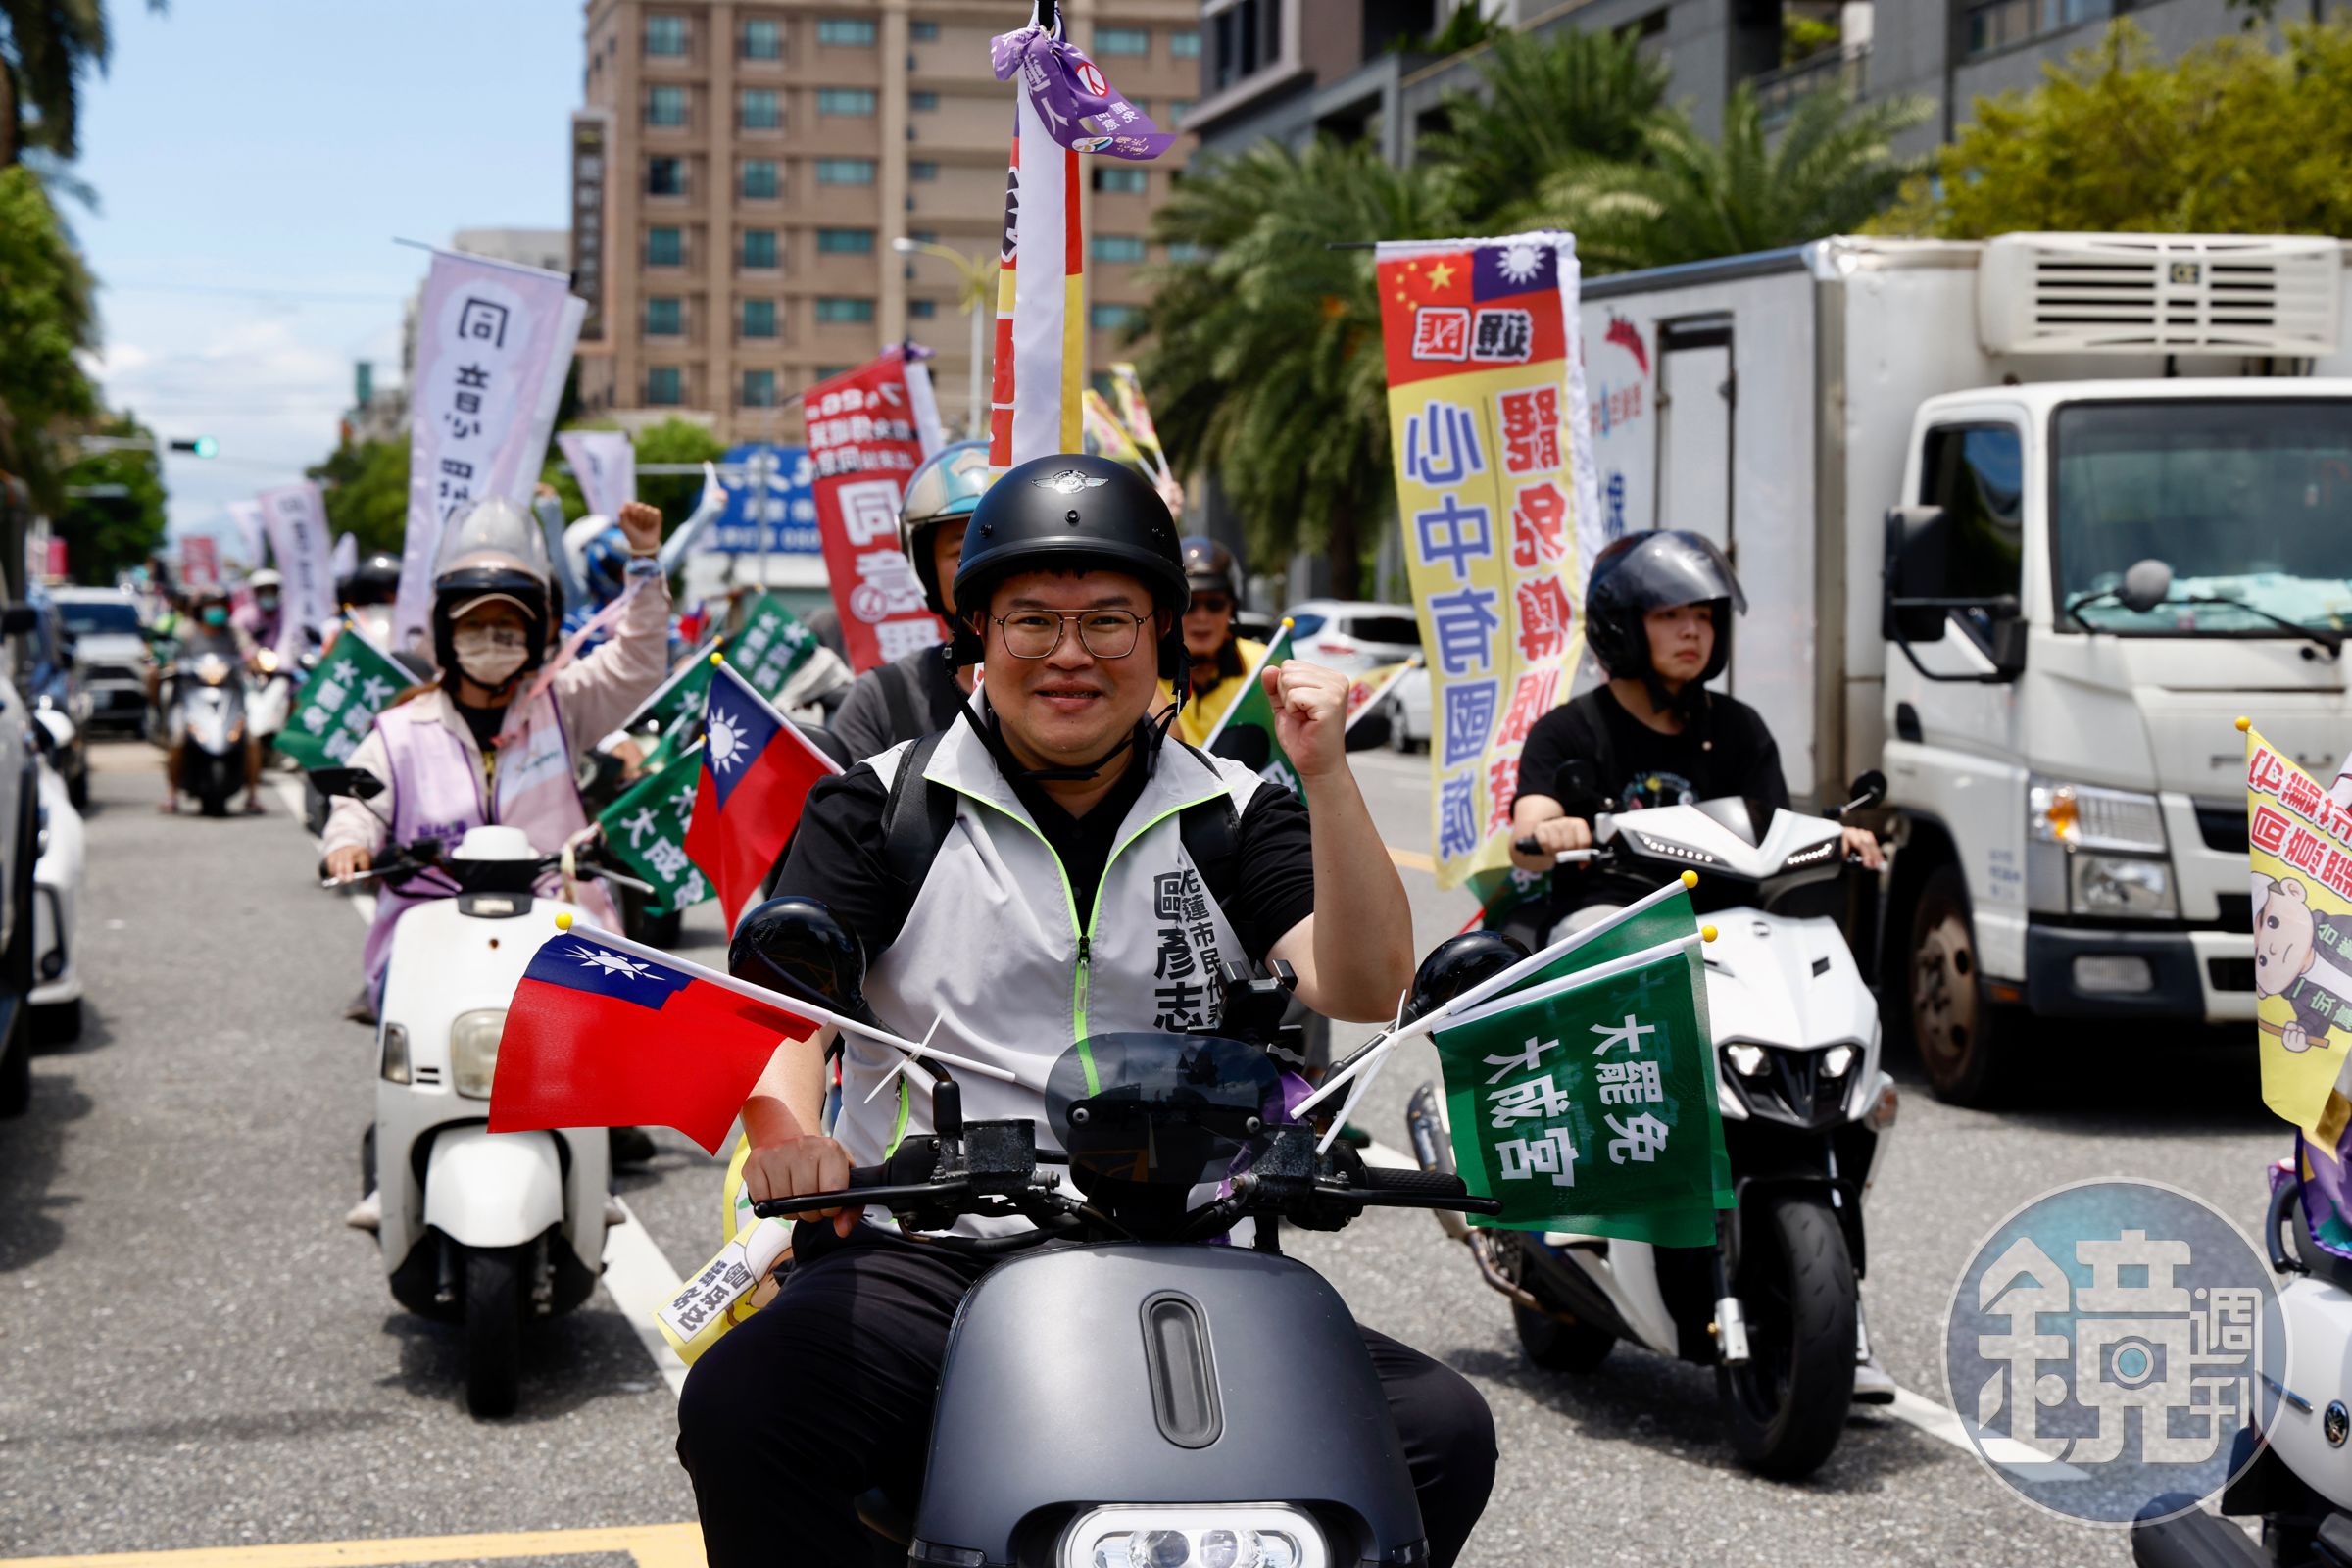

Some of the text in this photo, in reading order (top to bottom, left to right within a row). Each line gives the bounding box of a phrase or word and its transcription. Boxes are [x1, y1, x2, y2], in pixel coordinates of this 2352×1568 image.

[1482, 1036, 1579, 1187] 大成宮
[1590, 1013, 1669, 1165] 大罷免
